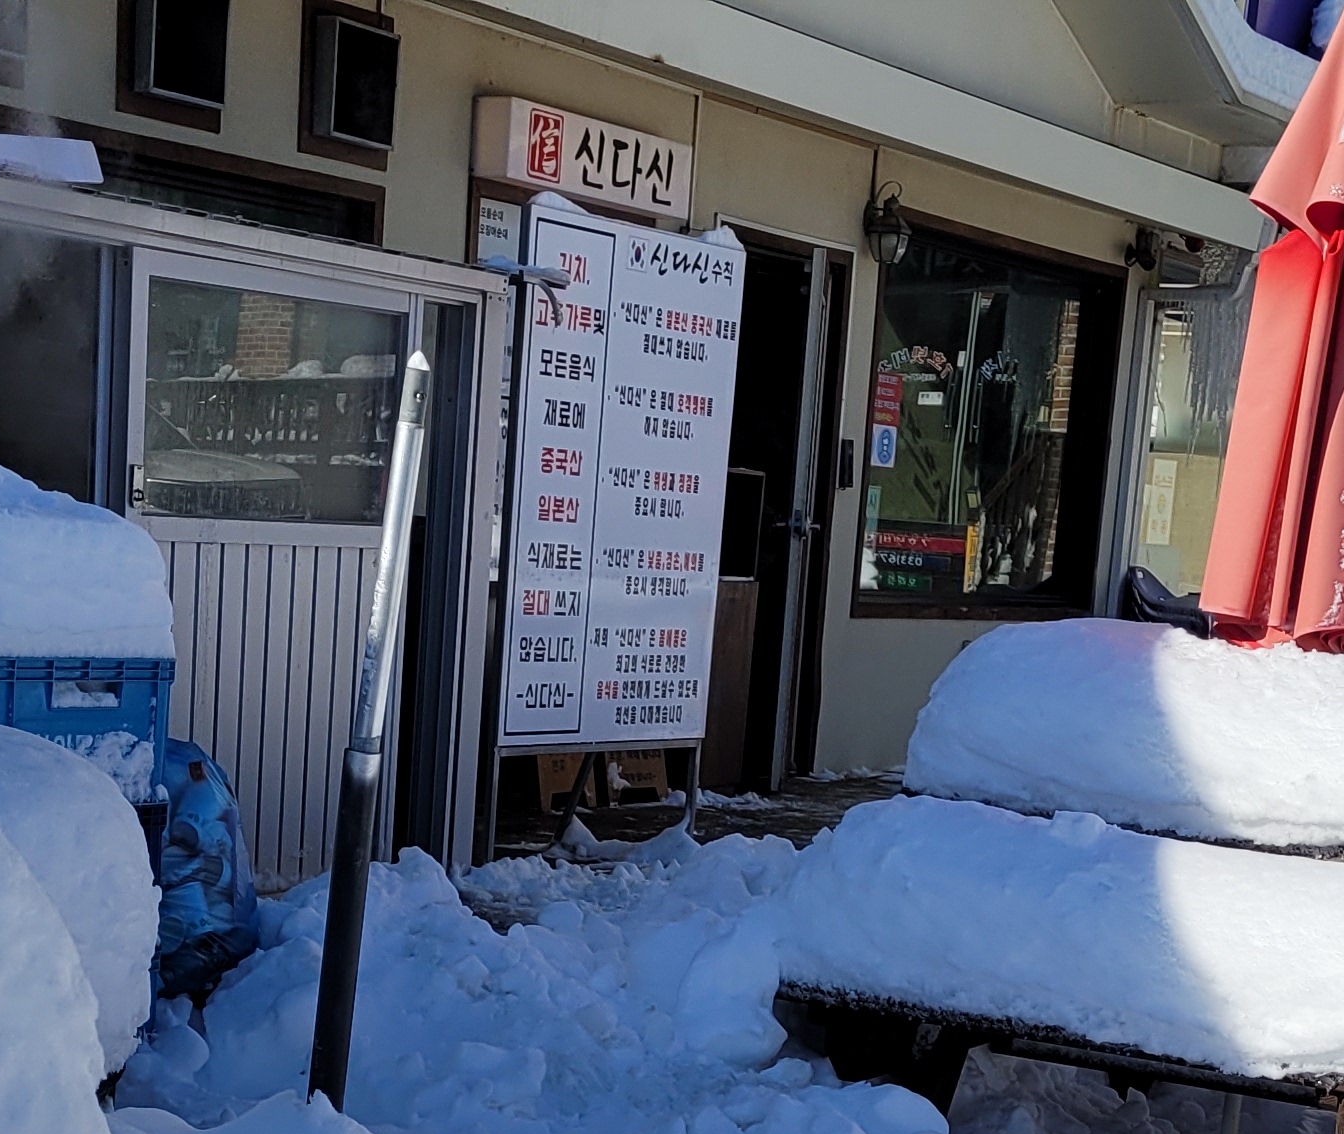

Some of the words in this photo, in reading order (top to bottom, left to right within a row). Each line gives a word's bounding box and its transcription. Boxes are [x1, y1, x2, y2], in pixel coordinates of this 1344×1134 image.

[575, 128, 674, 207] 신다신
[651, 243, 709, 284] 신다신
[712, 260, 734, 286] 수칙
[656, 308, 663, 328] 은
[666, 310, 688, 332] 일본산
[691, 315, 713, 336] 중국산
[676, 339, 708, 362] 않습니다.
[540, 349, 596, 382] 모든음식
[650, 390, 657, 409] 은
[660, 391, 675, 412] 절대
[543, 399, 586, 430] 재료에
[540, 447, 582, 476] 중국산
[643, 470, 650, 490] 은
[538, 495, 580, 523] 일본산
[527, 542, 582, 570] 식재료는
[638, 550, 644, 569] 은
[523, 590, 549, 616] 절대
[554, 593, 581, 617] 쓰지
[519, 637, 577, 663] 않습니다.
[650, 631, 656, 647] 은
[615, 655, 637, 674] 최고의
[516, 683, 574, 709] -신다신-
[597, 680, 619, 700] 음식을
[622, 680, 650, 699] 안전하게
[615, 705, 637, 725] 최선을
